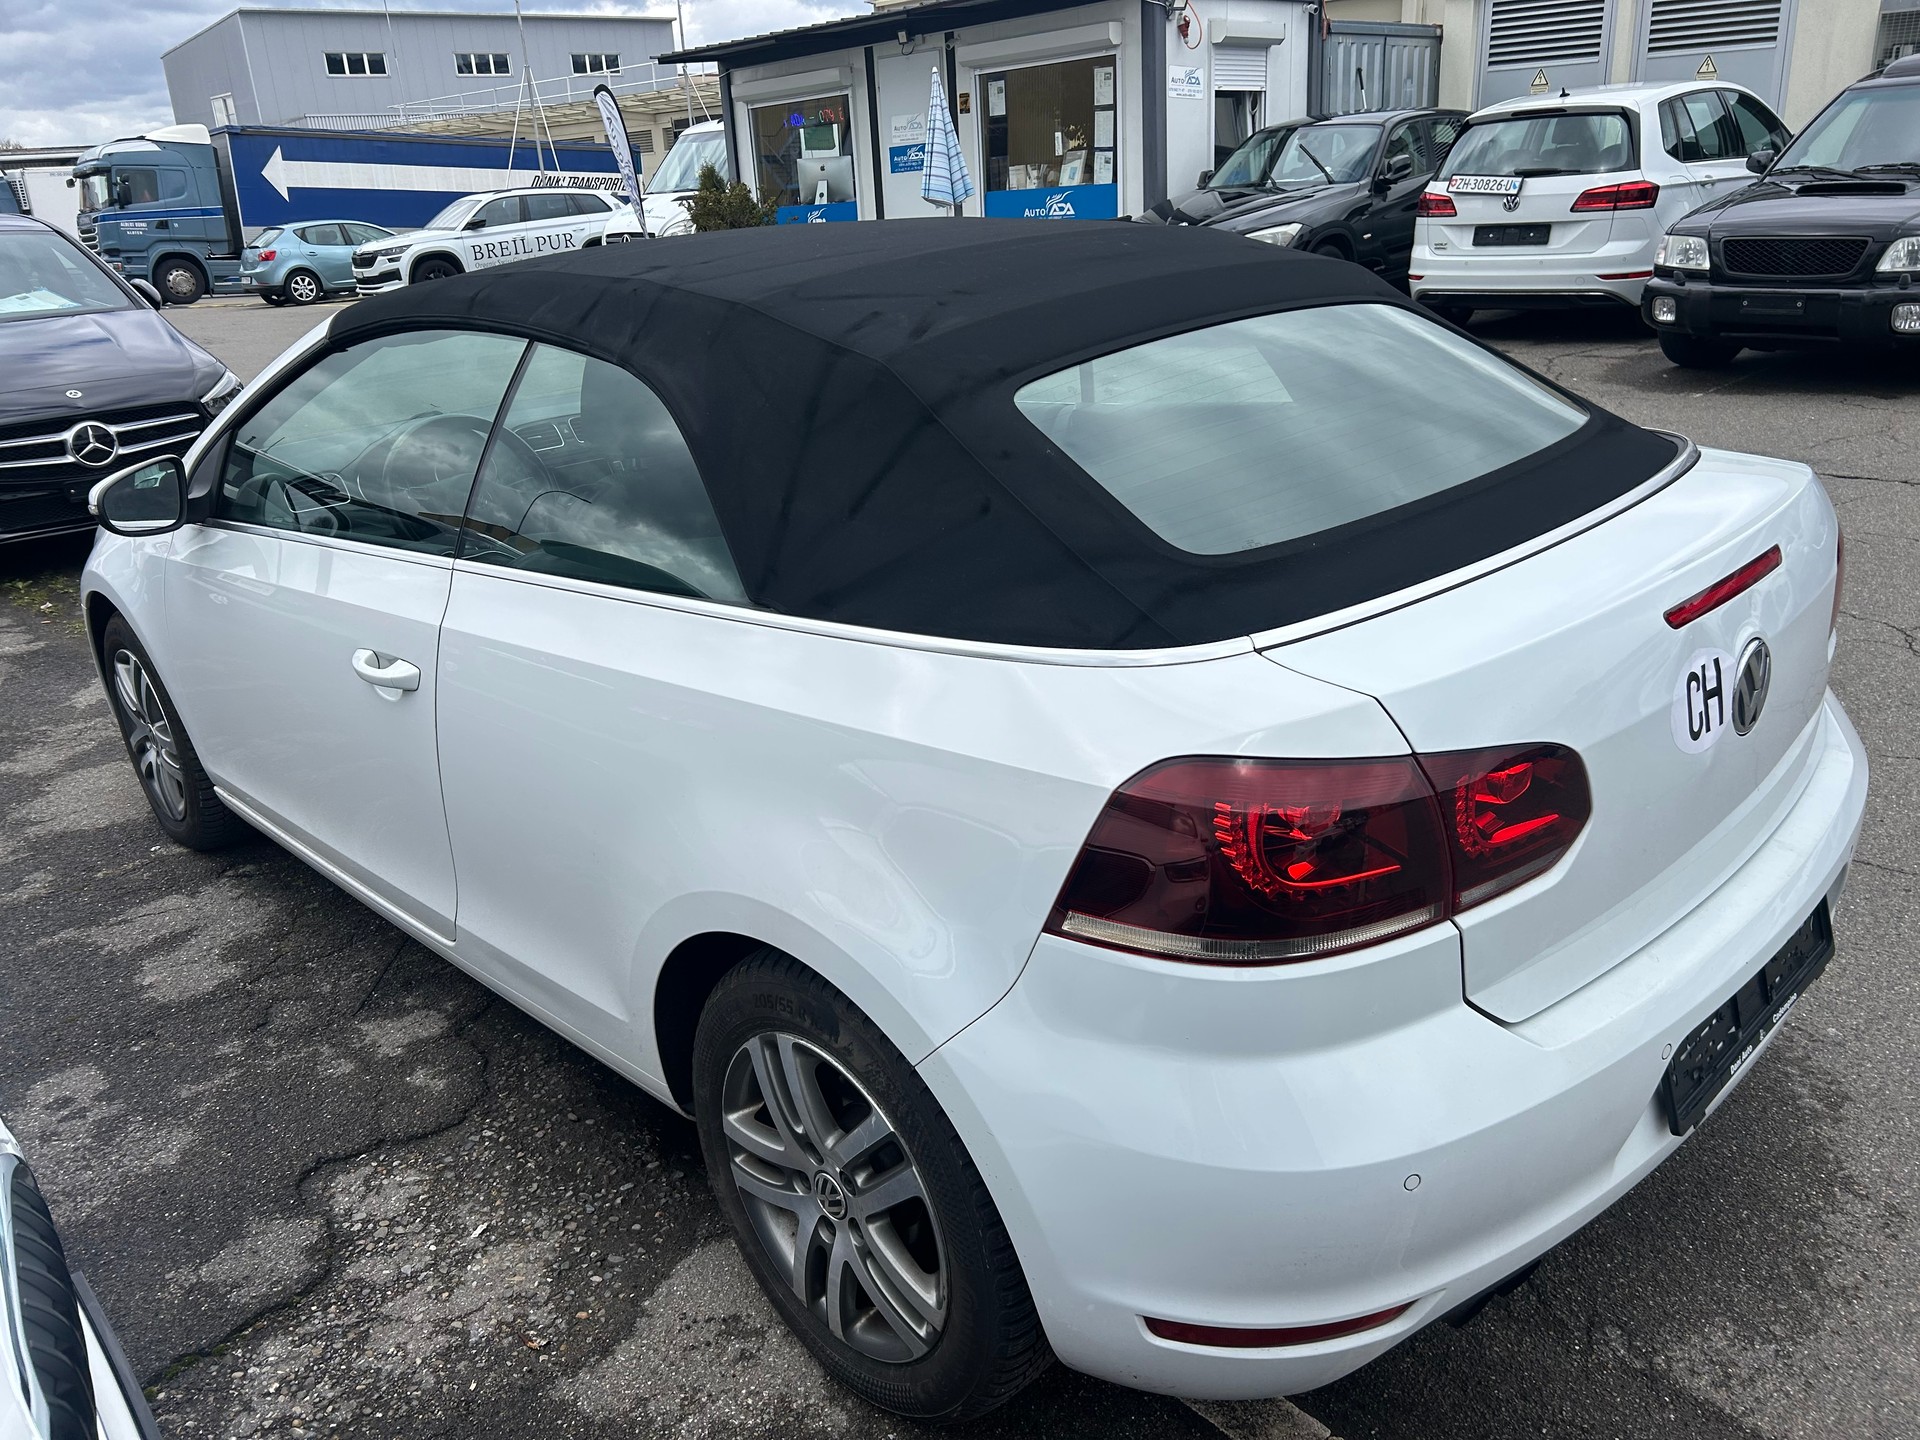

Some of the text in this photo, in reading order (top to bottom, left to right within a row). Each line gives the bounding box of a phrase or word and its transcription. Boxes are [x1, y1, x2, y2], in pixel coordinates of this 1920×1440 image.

[1023, 202, 1076, 218] AUTO ADA
[470, 232, 576, 261] BREIL PUR
[1685, 656, 1725, 742] CH
